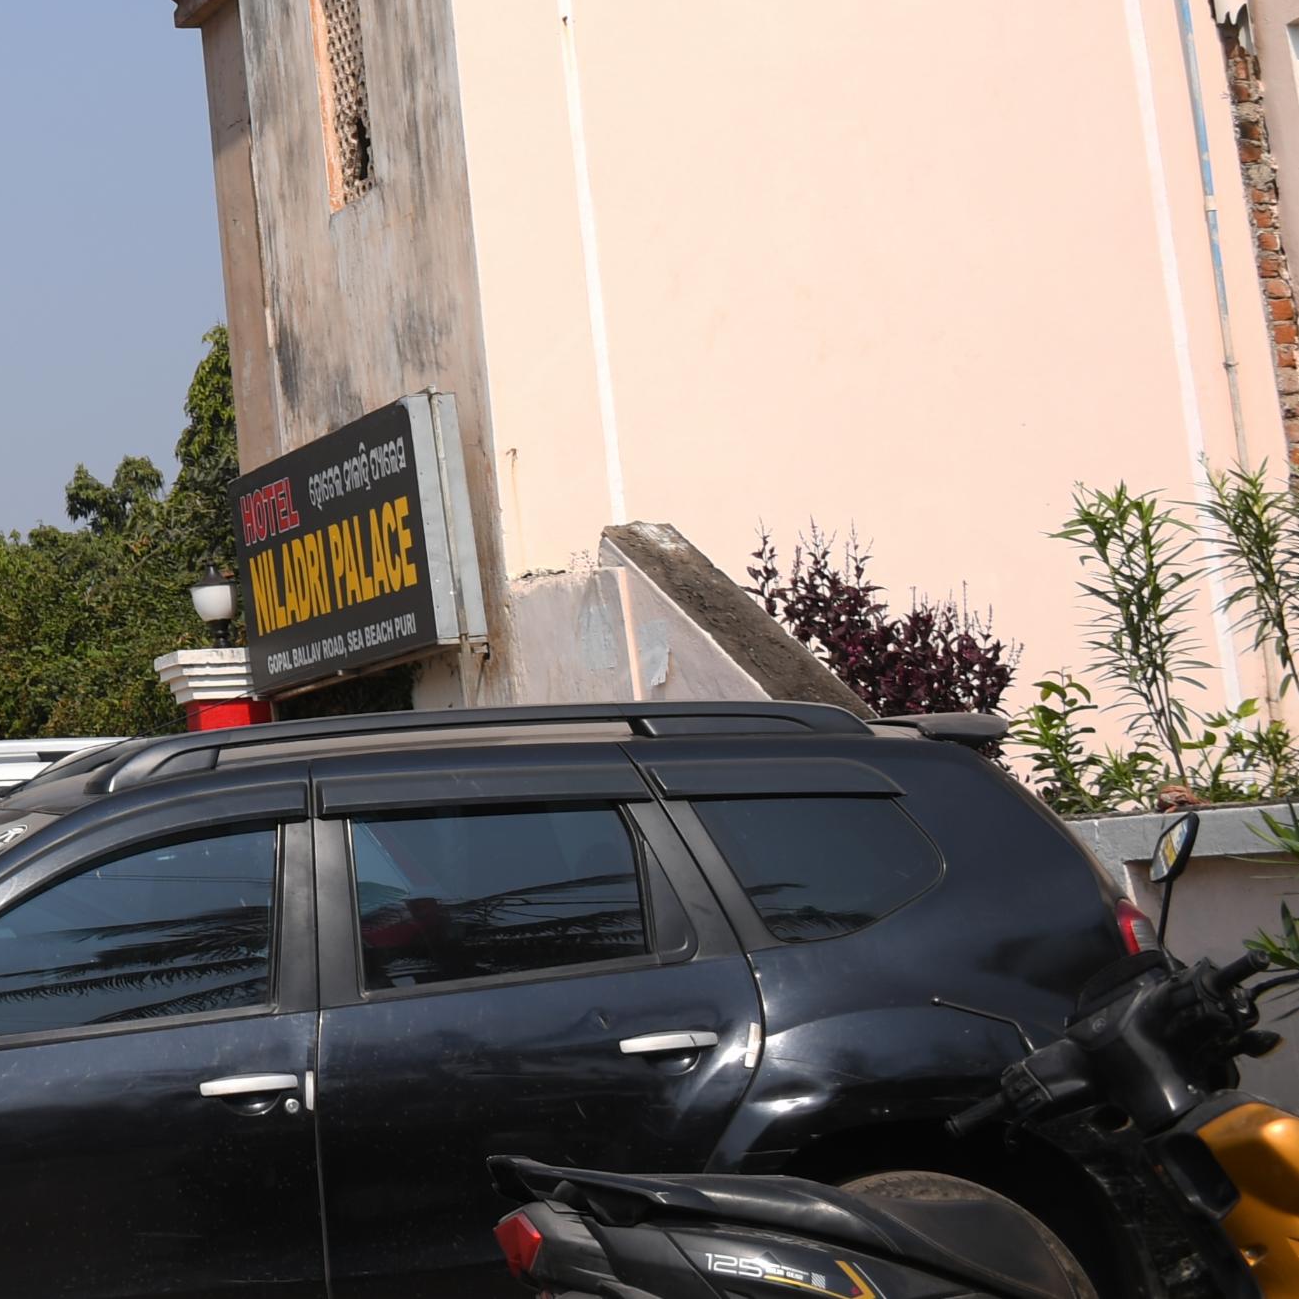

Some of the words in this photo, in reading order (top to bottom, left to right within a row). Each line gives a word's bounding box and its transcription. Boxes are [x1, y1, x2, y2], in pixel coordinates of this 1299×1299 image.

[240, 477, 299, 546] HOTEL
[249, 530, 331, 636] NILADRI
[329, 496, 417, 609] PALACE
[267, 651, 293, 675] GOPAL
[292, 641, 322, 668] BALLAV
[321, 634, 348, 658] ROAD,
[347, 628, 364, 652] SEA
[364, 619, 394, 647] BEACH
[394, 612, 417, 639] PURI
[705, 1252, 763, 1279] 125
